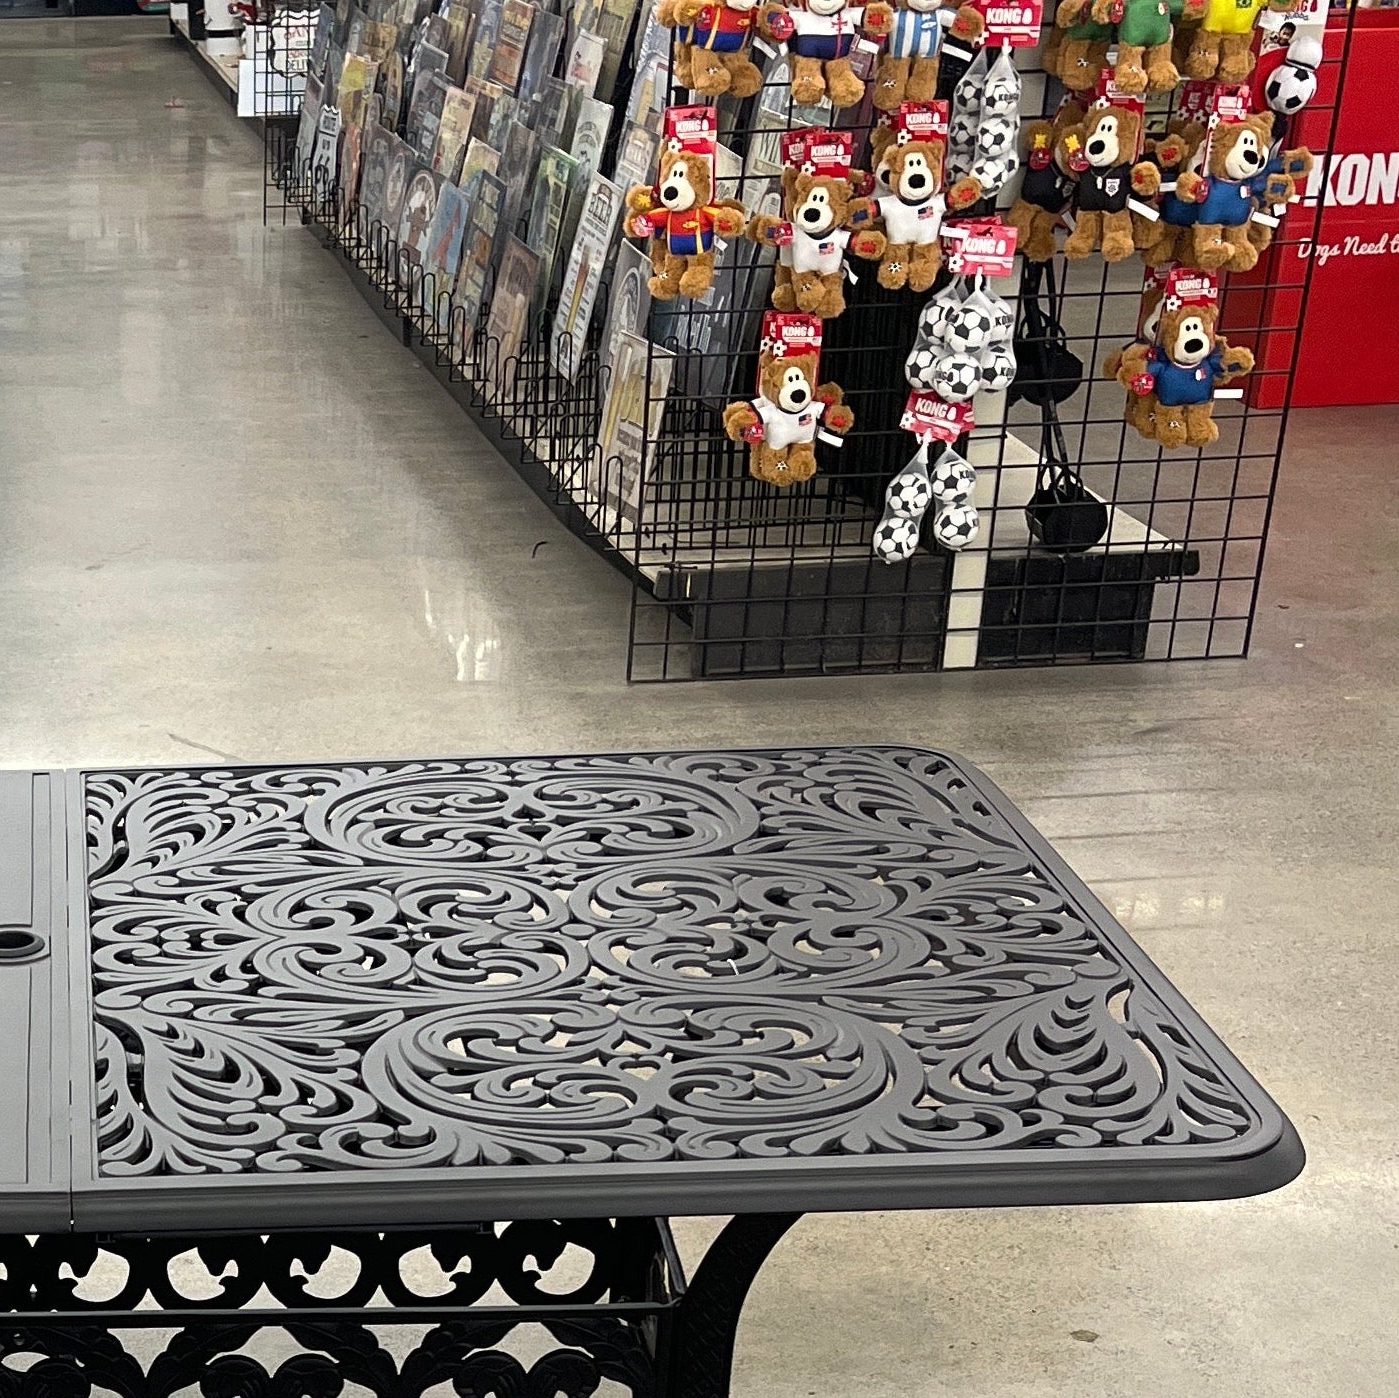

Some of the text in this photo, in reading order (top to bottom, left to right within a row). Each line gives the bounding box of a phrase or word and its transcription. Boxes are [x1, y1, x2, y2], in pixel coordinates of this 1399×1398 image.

[986, 8, 1022, 24] KONG
[676, 119, 701, 132] KONG
[906, 112, 933, 124] KONG
[810, 145, 837, 157] KONG
[1303, 152, 1399, 207] KON
[963, 238, 995, 254] KONG
[1343, 232, 1389, 256] Need
[1175, 278, 1202, 292] KONG
[782, 325, 808, 337] KONG
[914, 397, 948, 418] KONG
